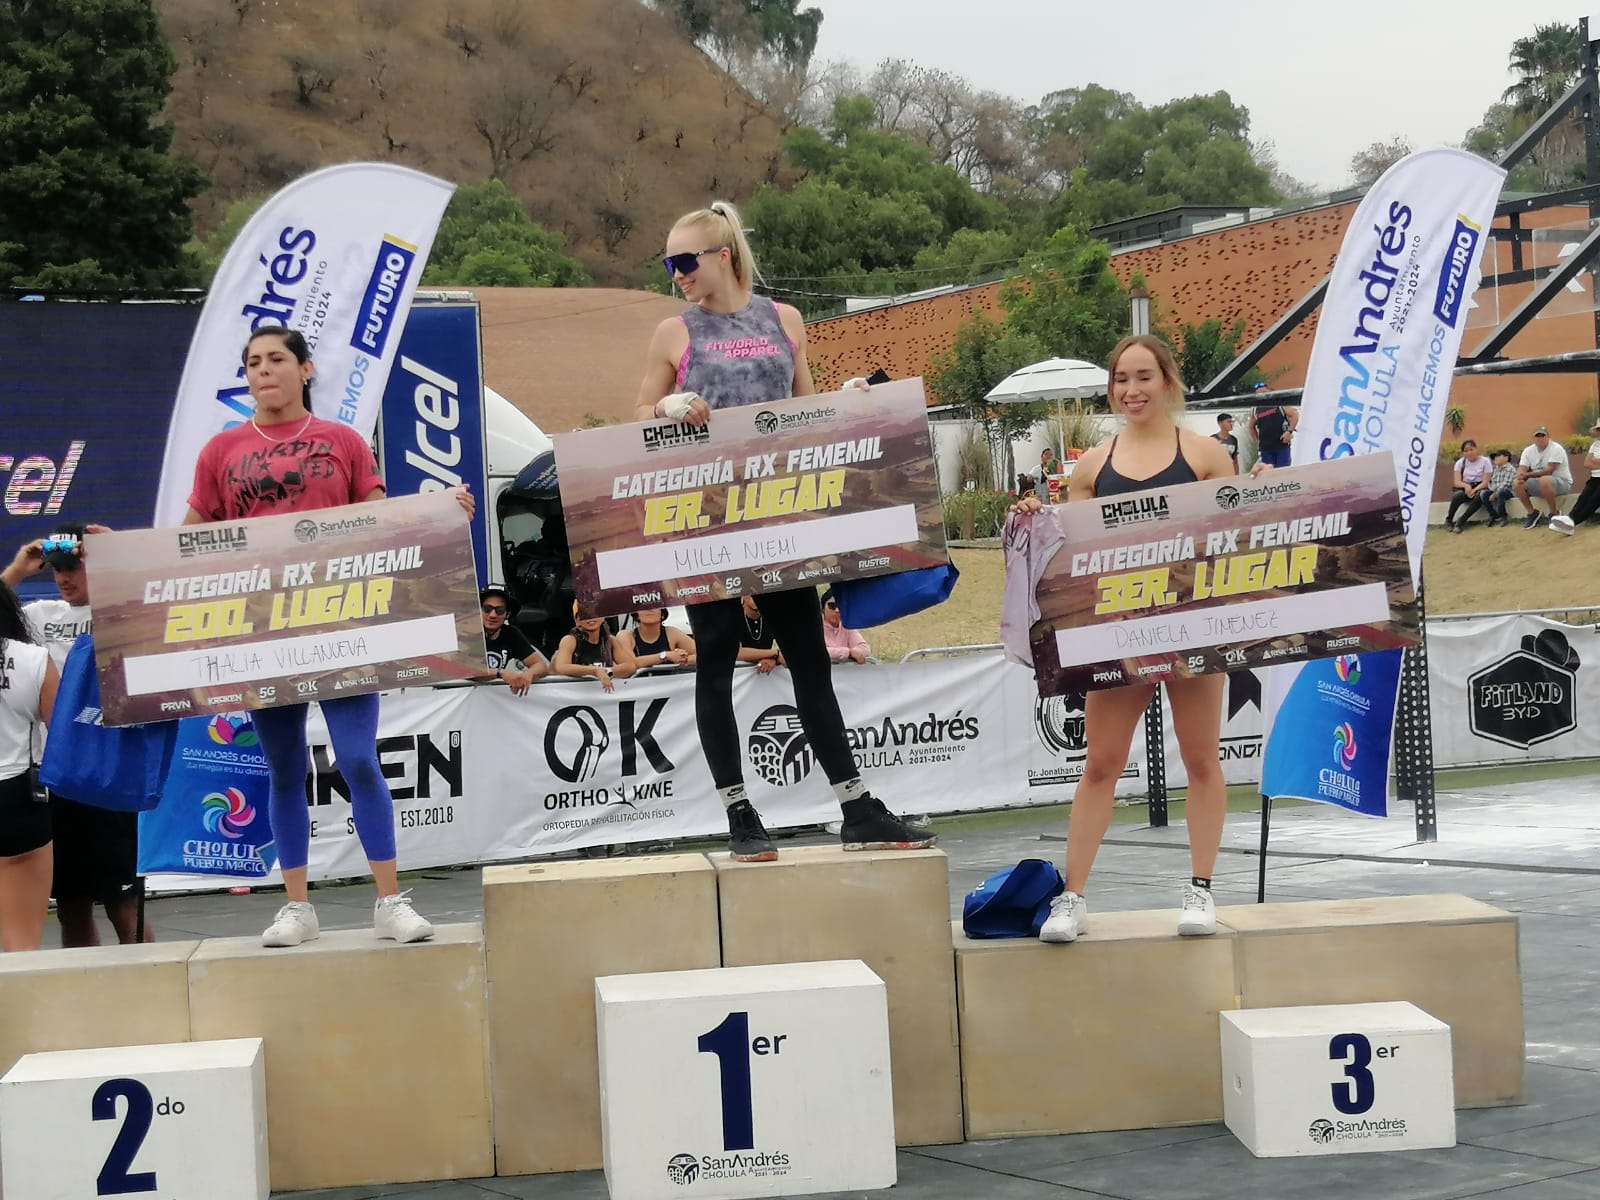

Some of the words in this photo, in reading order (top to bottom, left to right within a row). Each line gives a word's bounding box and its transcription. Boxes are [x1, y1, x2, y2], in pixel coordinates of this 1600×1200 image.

[1440, 231, 1473, 319] FUTURO
[361, 251, 405, 349] FUTURO
[724, 345, 781, 358] APPAREL
[337, 354, 370, 425] EMOS
[1414, 324, 1446, 434] HACEMOS
[780, 407, 836, 424] SanAndrés
[1362, 344, 1400, 455] HOLULA
[611, 456, 734, 500] CATEGORÍA
[744, 452, 777, 480] RX
[787, 436, 884, 473] FEMEMIL
[643, 491, 710, 537] 1ER.
[725, 470, 846, 524] LUGAR
[1242, 481, 1301, 499] SanAndrés
[320, 515, 377, 533] SanAndrés
[674, 543, 732, 572] MILLA
[744, 535, 797, 560] NIEMI
[1071, 533, 1195, 577] CATEGORÍA
[1206, 528, 1241, 557] RX
[1249, 511, 1352, 549] FEMEMIL
[143, 564, 272, 605] CATEGORÍA
[282, 561, 317, 588] RX
[325, 546, 425, 582] FEMEMIL
[632, 592, 661, 605] PRVN
[725, 576, 742, 590] 5G
[858, 557, 891, 569] RUSTER
[1095, 567, 1178, 615] 3ER.
[1192, 544, 1319, 600] LUGAR
[269, 577, 394, 631] LUGAR
[1106, 624, 1191, 649] DANIELA
[1203, 610, 1279, 637] JIMENEZ
[192, 653, 263, 682] THALIA
[274, 636, 368, 669] VILLANUEVA
[1093, 671, 1122, 683] PRVN
[1188, 655, 1204, 668] 5G
[1326, 636, 1360, 649] RUSTER
[161, 700, 191, 712] PRVN
[259, 686, 276, 699] 5G
[397, 667, 429, 679] RUSTER
[845, 710, 980, 750] anAndrés
[182, 747, 201, 757] SAN
[203, 748, 239, 761] ANDRÉS
[240, 753, 268, 765] CHOL
[852, 750, 904, 769] OLULA
[909, 744, 966, 757] Ayuntamiento
[909, 753, 952, 765] 2021-2024
[1027, 769, 1039, 778] Dr.
[1040, 766, 1074, 777] Jonathan
[543, 788, 609, 811] ORTHO
[632, 781, 673, 801] KINE
[401, 806, 454, 829] EST.2018
[543, 819, 590, 832] ORTOPEDIA
[652, 808, 676, 820] FÍSICA
[183, 839, 261, 860] CHOLUL
[1336, 1118, 1406, 1133] SanAndrés
[1336, 1131, 1371, 1140] CHOLULA
[701, 1151, 790, 1170] SanAndrés
[701, 1170, 747, 1180] CHOLULA
